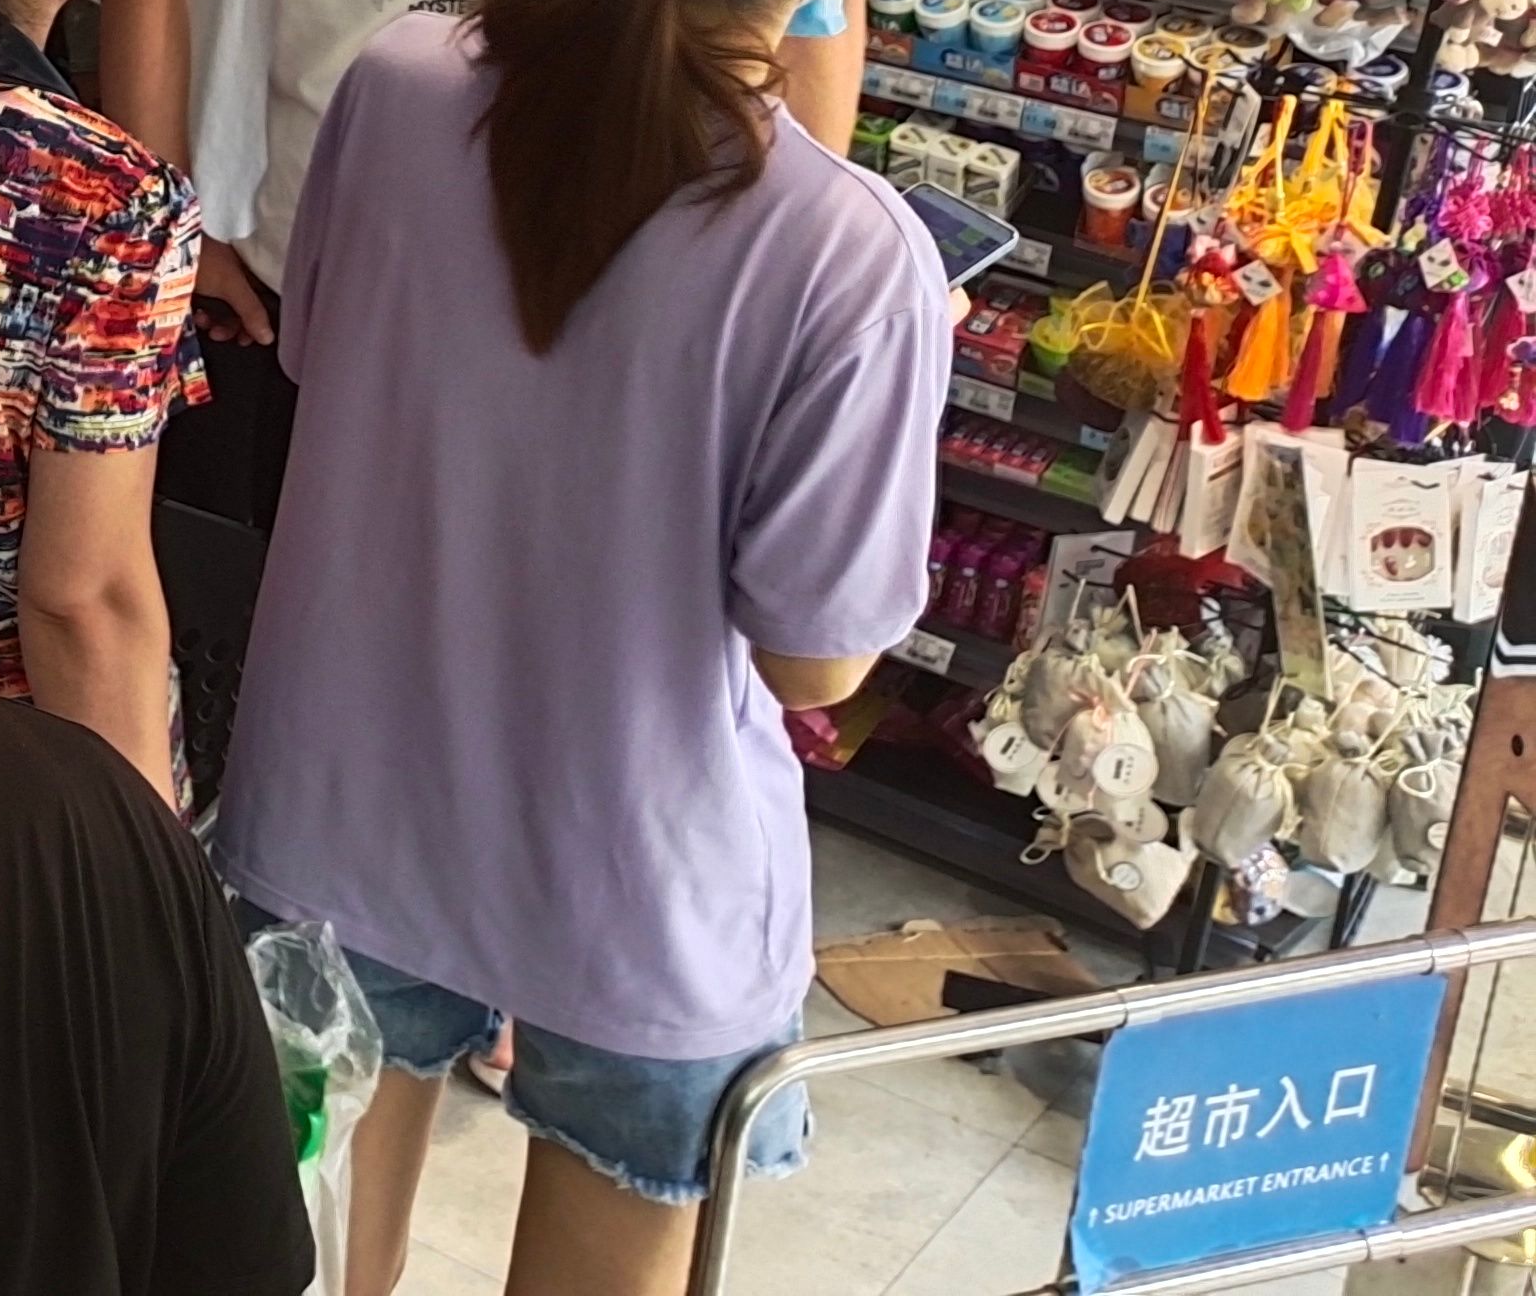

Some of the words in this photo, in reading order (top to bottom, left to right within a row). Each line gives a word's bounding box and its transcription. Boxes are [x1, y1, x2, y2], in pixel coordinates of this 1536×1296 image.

[1134, 1062, 1378, 1164] 超市入口
[1104, 1175, 1258, 1224] SUPERMARKET
[1260, 1154, 1375, 1195] ENTRANCE
